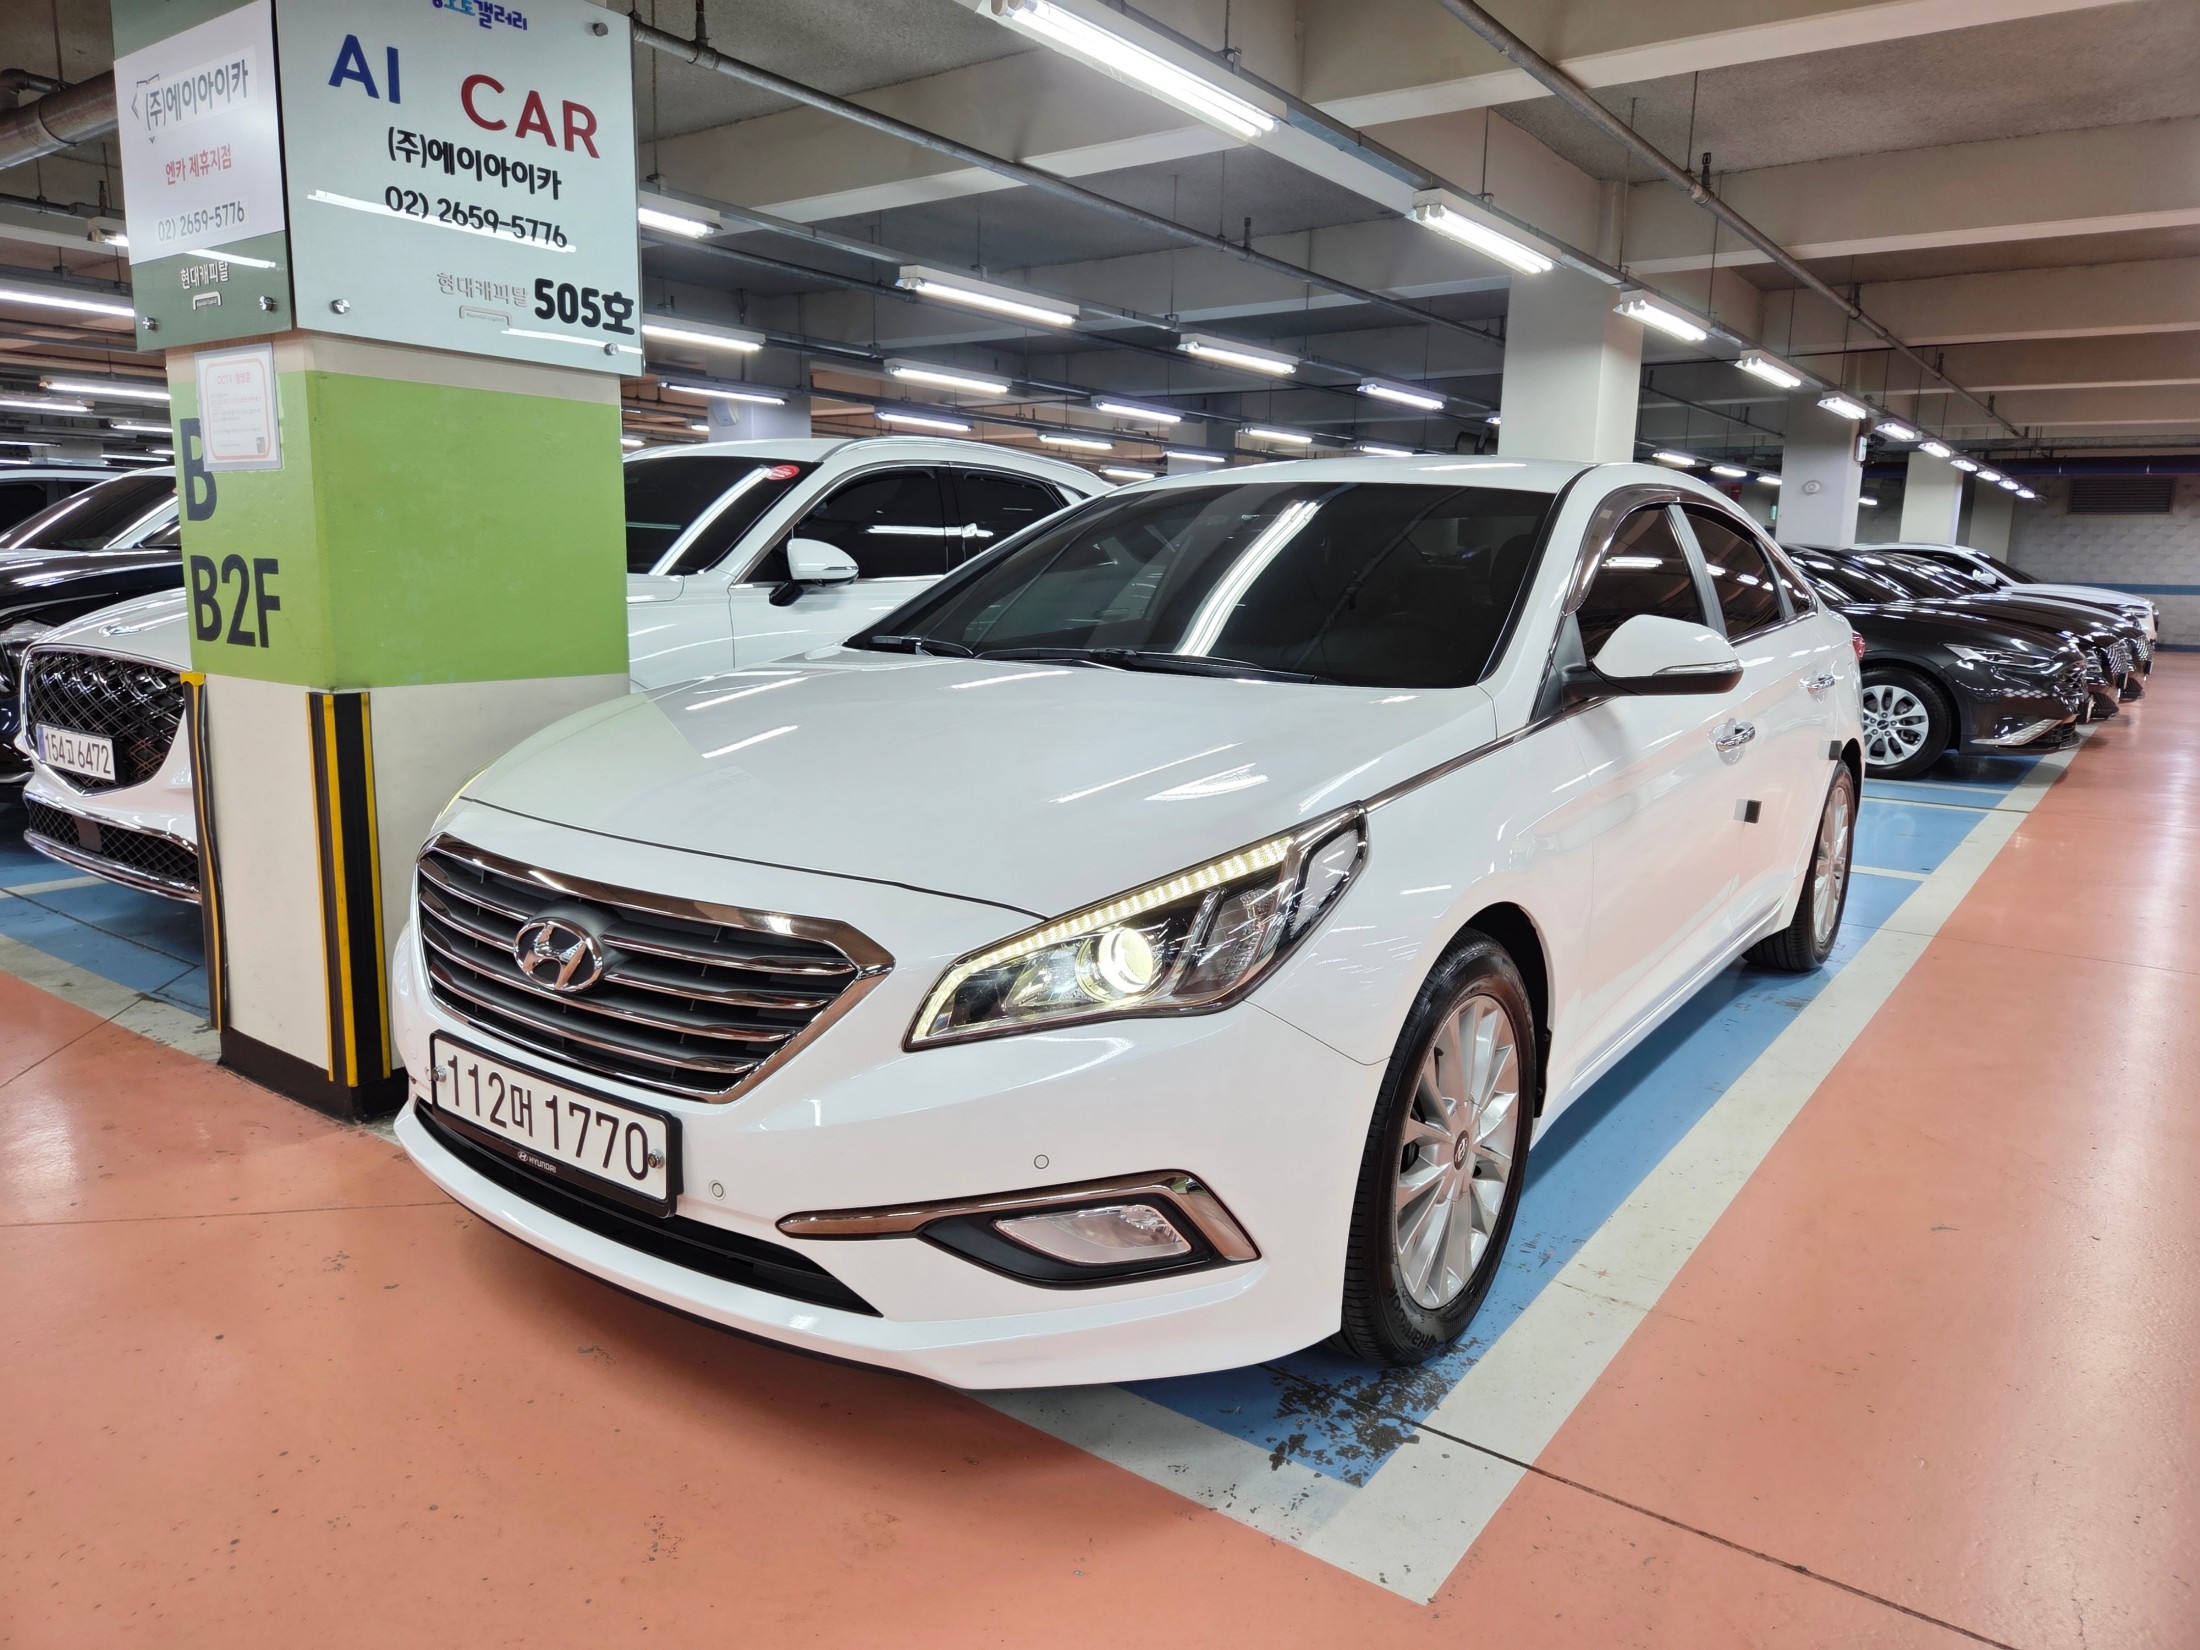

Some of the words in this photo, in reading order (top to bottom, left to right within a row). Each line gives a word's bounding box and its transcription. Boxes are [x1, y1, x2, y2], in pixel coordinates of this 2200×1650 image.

[145, 59, 249, 131] (주)에이아이카
[328, 34, 401, 105] AI
[460, 74, 600, 159] CAR
[165, 158, 186, 186] 엔카
[189, 143, 232, 176] 제휴지점
[388, 126, 562, 200] (주)에이아이카
[157, 218, 177, 243] 02)
[180, 201, 245, 236] 2659-5776
[385, 186, 430, 220] 02)
[437, 198, 568, 248] 2659-5776
[180, 261, 230, 290] 현대캐피탈
[437, 272, 529, 308] 현대캐피탈
[534, 278, 635, 336] 505호
[179, 418, 217, 521] B
[190, 554, 281, 648] B2F
[528, 1156, 557, 1174] HYUNDAI
